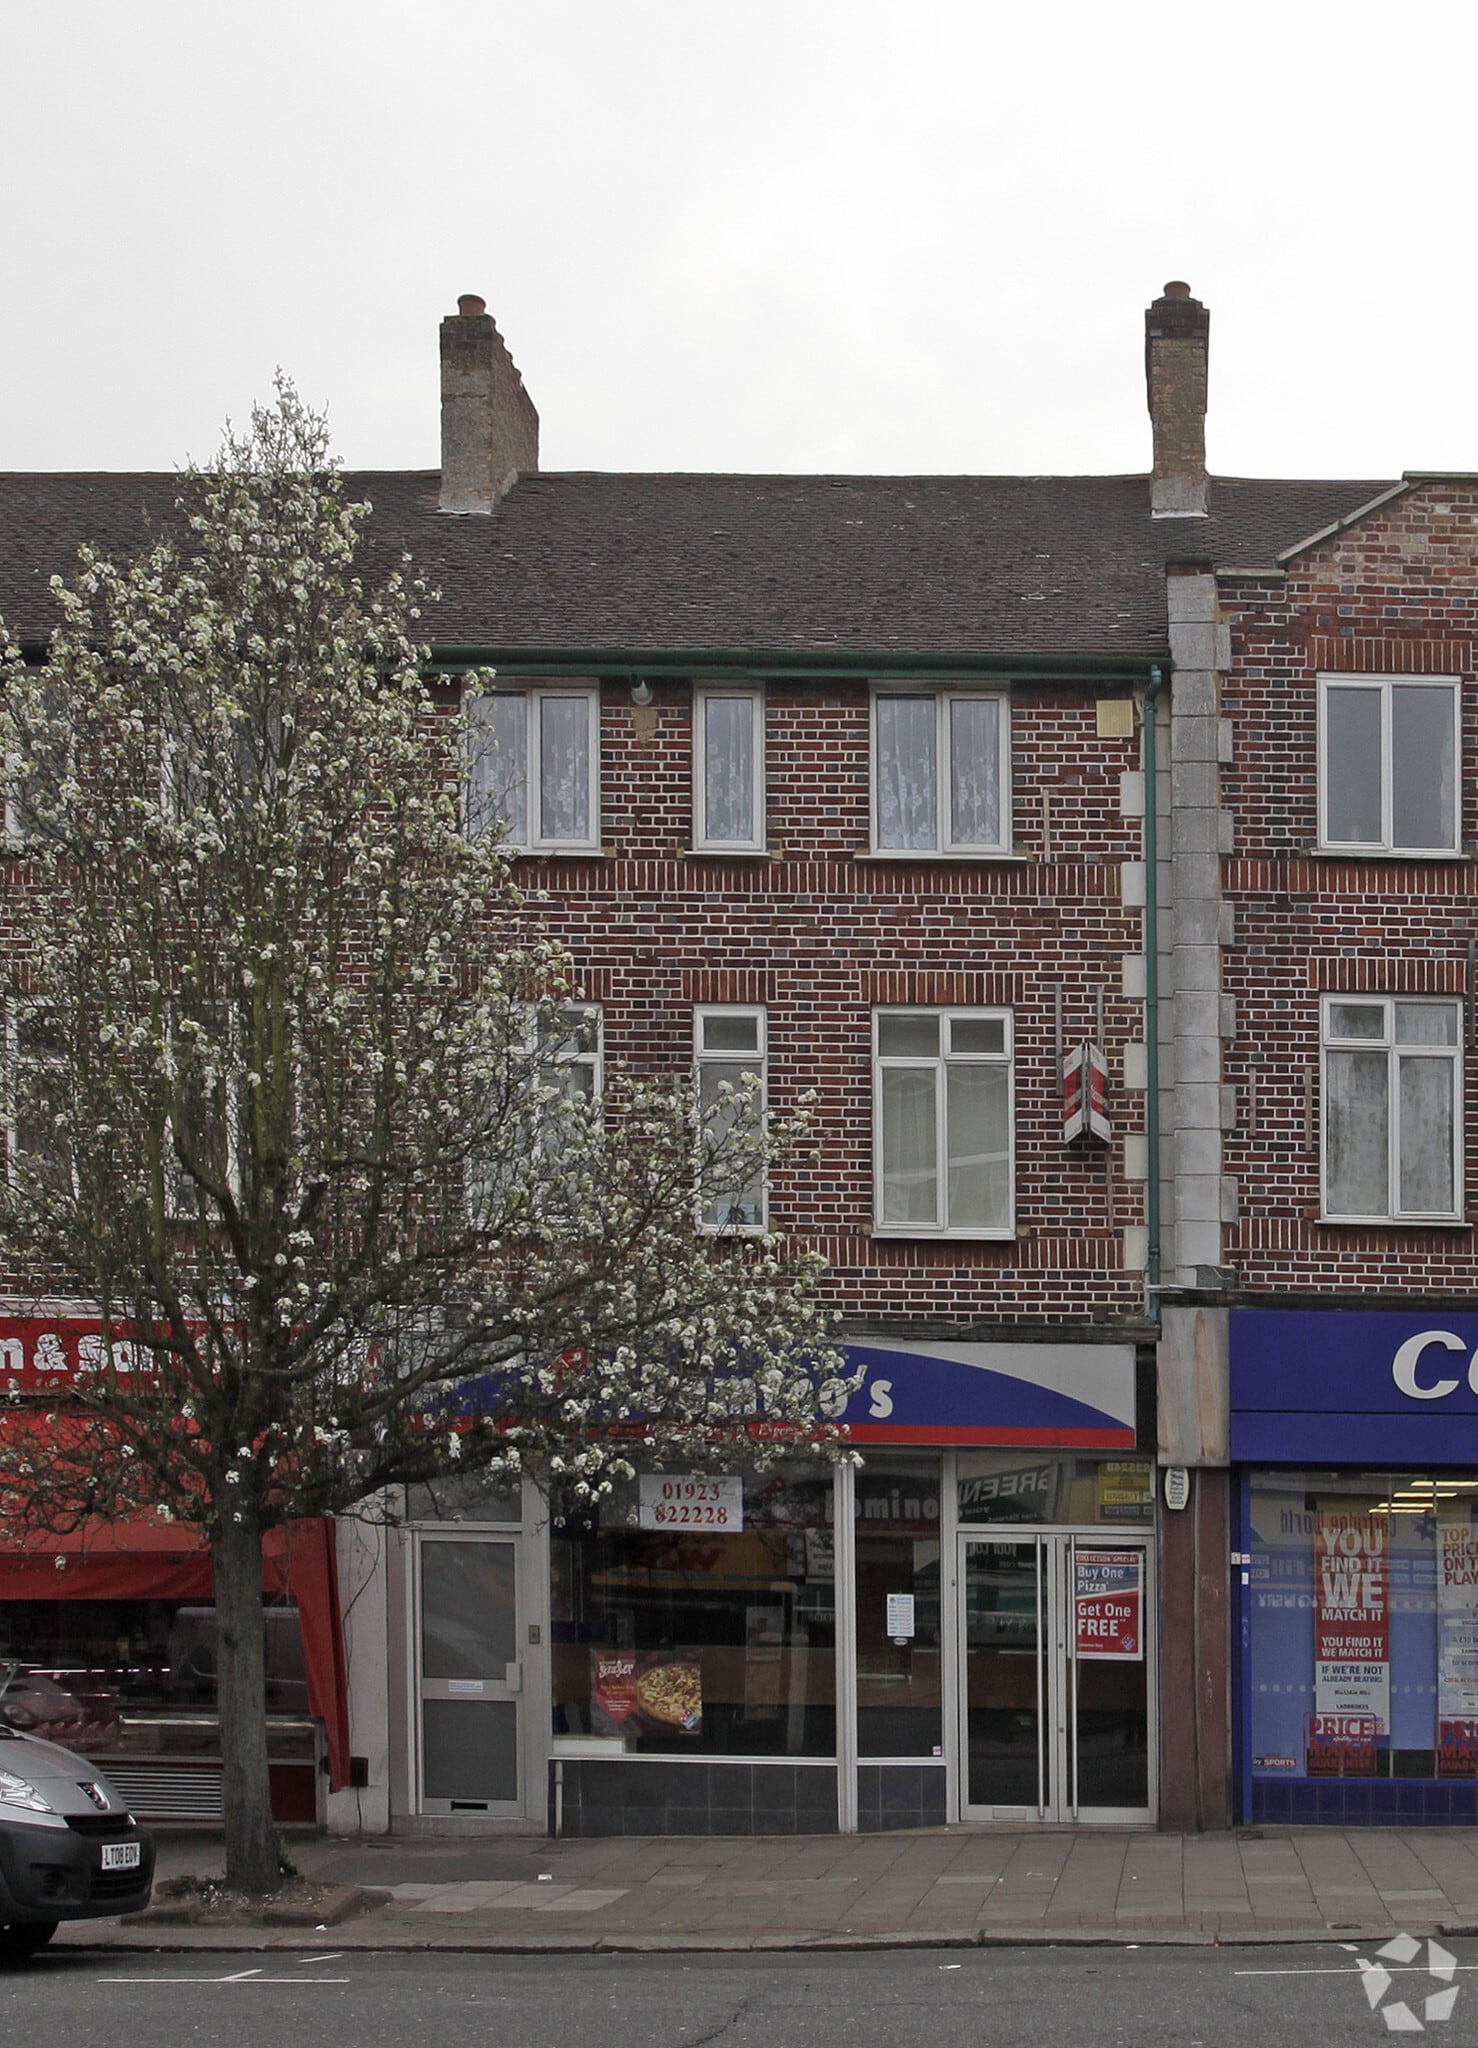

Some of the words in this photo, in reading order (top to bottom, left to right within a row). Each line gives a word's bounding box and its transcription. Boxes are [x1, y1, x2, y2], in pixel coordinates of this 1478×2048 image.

[33, 1333, 69, 1371] &
[1392, 1329, 1478, 1400] C
[662, 1483, 720, 1501] 01923
[655, 1505, 728, 1525] 822228
[1321, 1528, 1383, 1556] YOU
[1442, 1528, 1469, 1541] TOP
[1322, 1557, 1361, 1573] FIND
[1367, 1557, 1383, 1573] IT
[1444, 1558, 1465, 1571] ON
[1469, 1556, 1478, 1570] T
[1077, 1566, 1100, 1580] Buy
[1102, 1567, 1124, 1578] One
[1322, 1573, 1384, 1608] WE
[1078, 1602, 1101, 1616] Get
[1104, 1603, 1131, 1617] One
[1322, 1609, 1367, 1621] MATCH
[1371, 1609, 1383, 1621] IT
[1322, 1637, 1342, 1647] YOU
[1346, 1637, 1370, 1647] FIND
[1374, 1637, 1383, 1648] IT
[1322, 1648, 1336, 1657] WE
[1339, 1648, 1371, 1657] MATCH
[1375, 1648, 1383, 1657] IT
[1321, 1665, 1329, 1674] IF
[1332, 1665, 1360, 1674] WE'RE
[1363, 1666, 1383, 1675] NOT
[1322, 1675, 1352, 1683] ALREADY
[1309, 1718, 1371, 1738] PRICE
[1440, 1720, 1478, 1741] PRI
